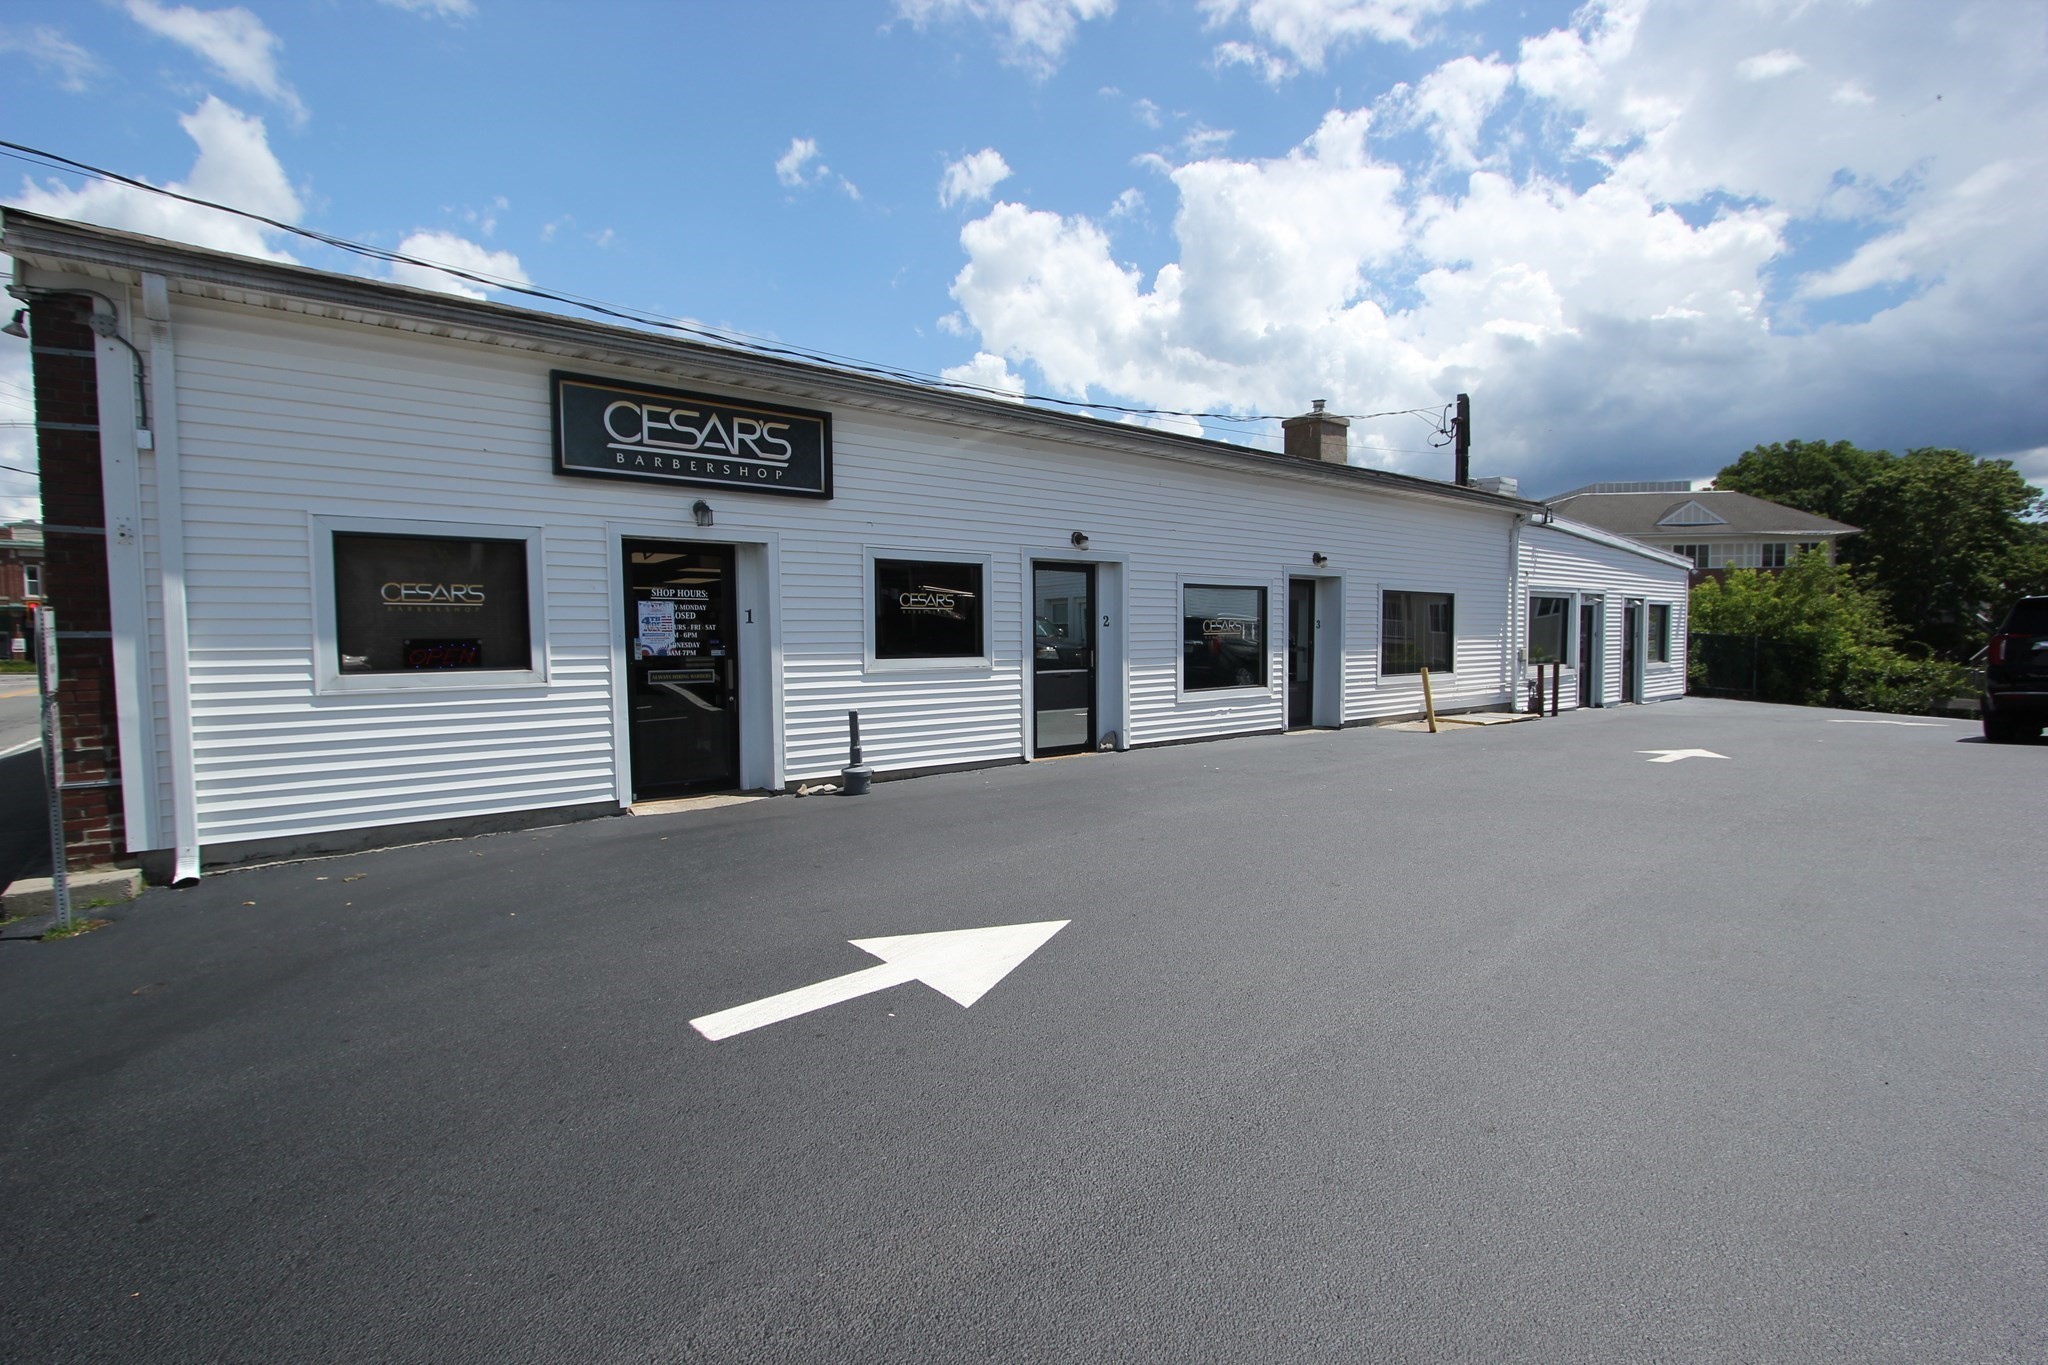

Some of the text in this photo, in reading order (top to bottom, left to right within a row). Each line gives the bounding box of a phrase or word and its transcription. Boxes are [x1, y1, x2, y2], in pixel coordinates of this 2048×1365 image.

[604, 401, 792, 460] CESAR'S
[617, 453, 782, 480] BARBERSHOP
[381, 583, 485, 602] CESAR'S
[651, 589, 708, 598] SHOP HOURS:
[744, 609, 754, 624] 1
[1103, 615, 1110, 627] 2
[1316, 620, 1321, 629] 3
